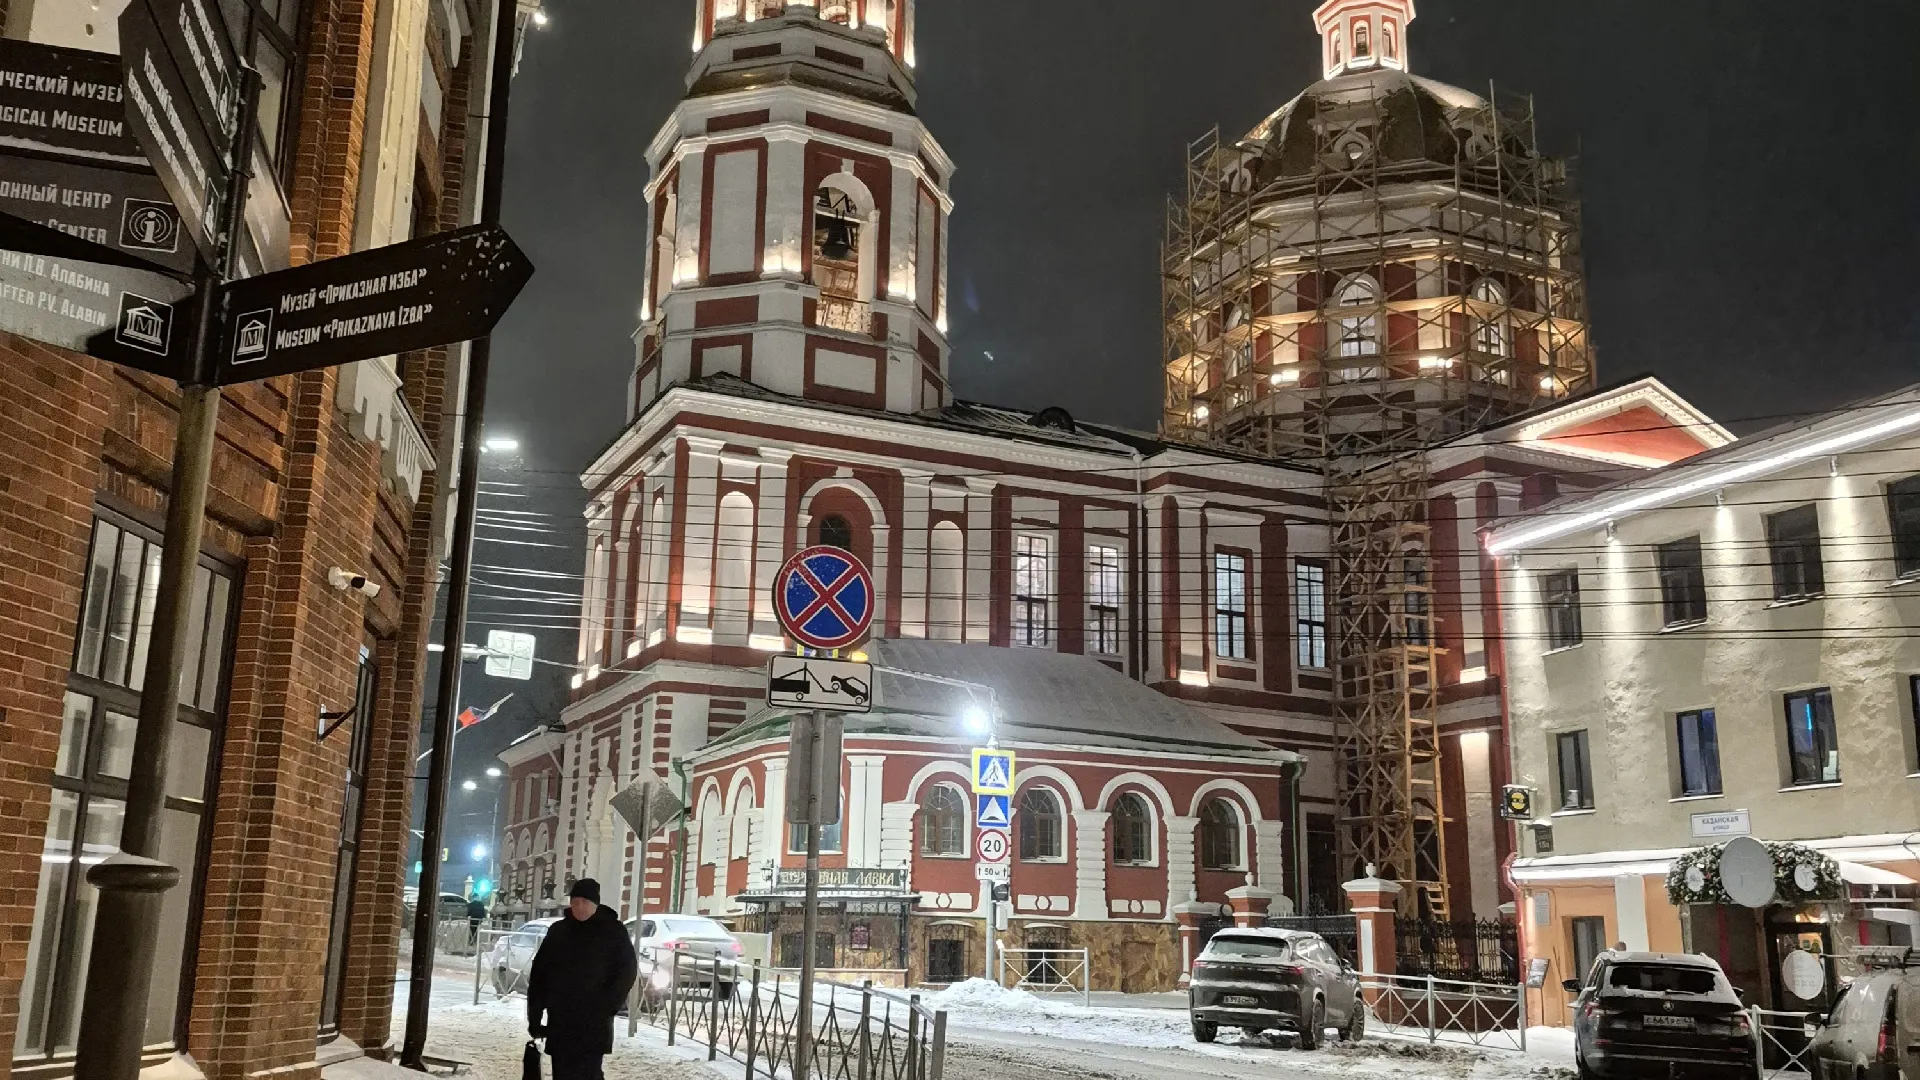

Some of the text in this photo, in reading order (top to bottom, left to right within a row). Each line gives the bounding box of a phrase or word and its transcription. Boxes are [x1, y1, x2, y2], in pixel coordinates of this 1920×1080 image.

[52, 109, 123, 137] MUSEUM
[62, 188, 112, 209] ЦЕНТР
[23, 254, 47, 278] П.В.
[51, 263, 110, 297] АЛАБИНА
[280, 267, 427, 314] МУЗЕЙ «ПРИКАЗНАЯ ИЗБА»
[38, 291, 57, 314] P.V.
[60, 299, 107, 327] ALABIN
[275, 303, 433, 350] MUSEUM «PRIKAZNAYA IZBA»
[983, 839, 1002, 853] 20
[854, 871, 894, 886] ЛАВКА
[984, 867, 994, 876] 50
